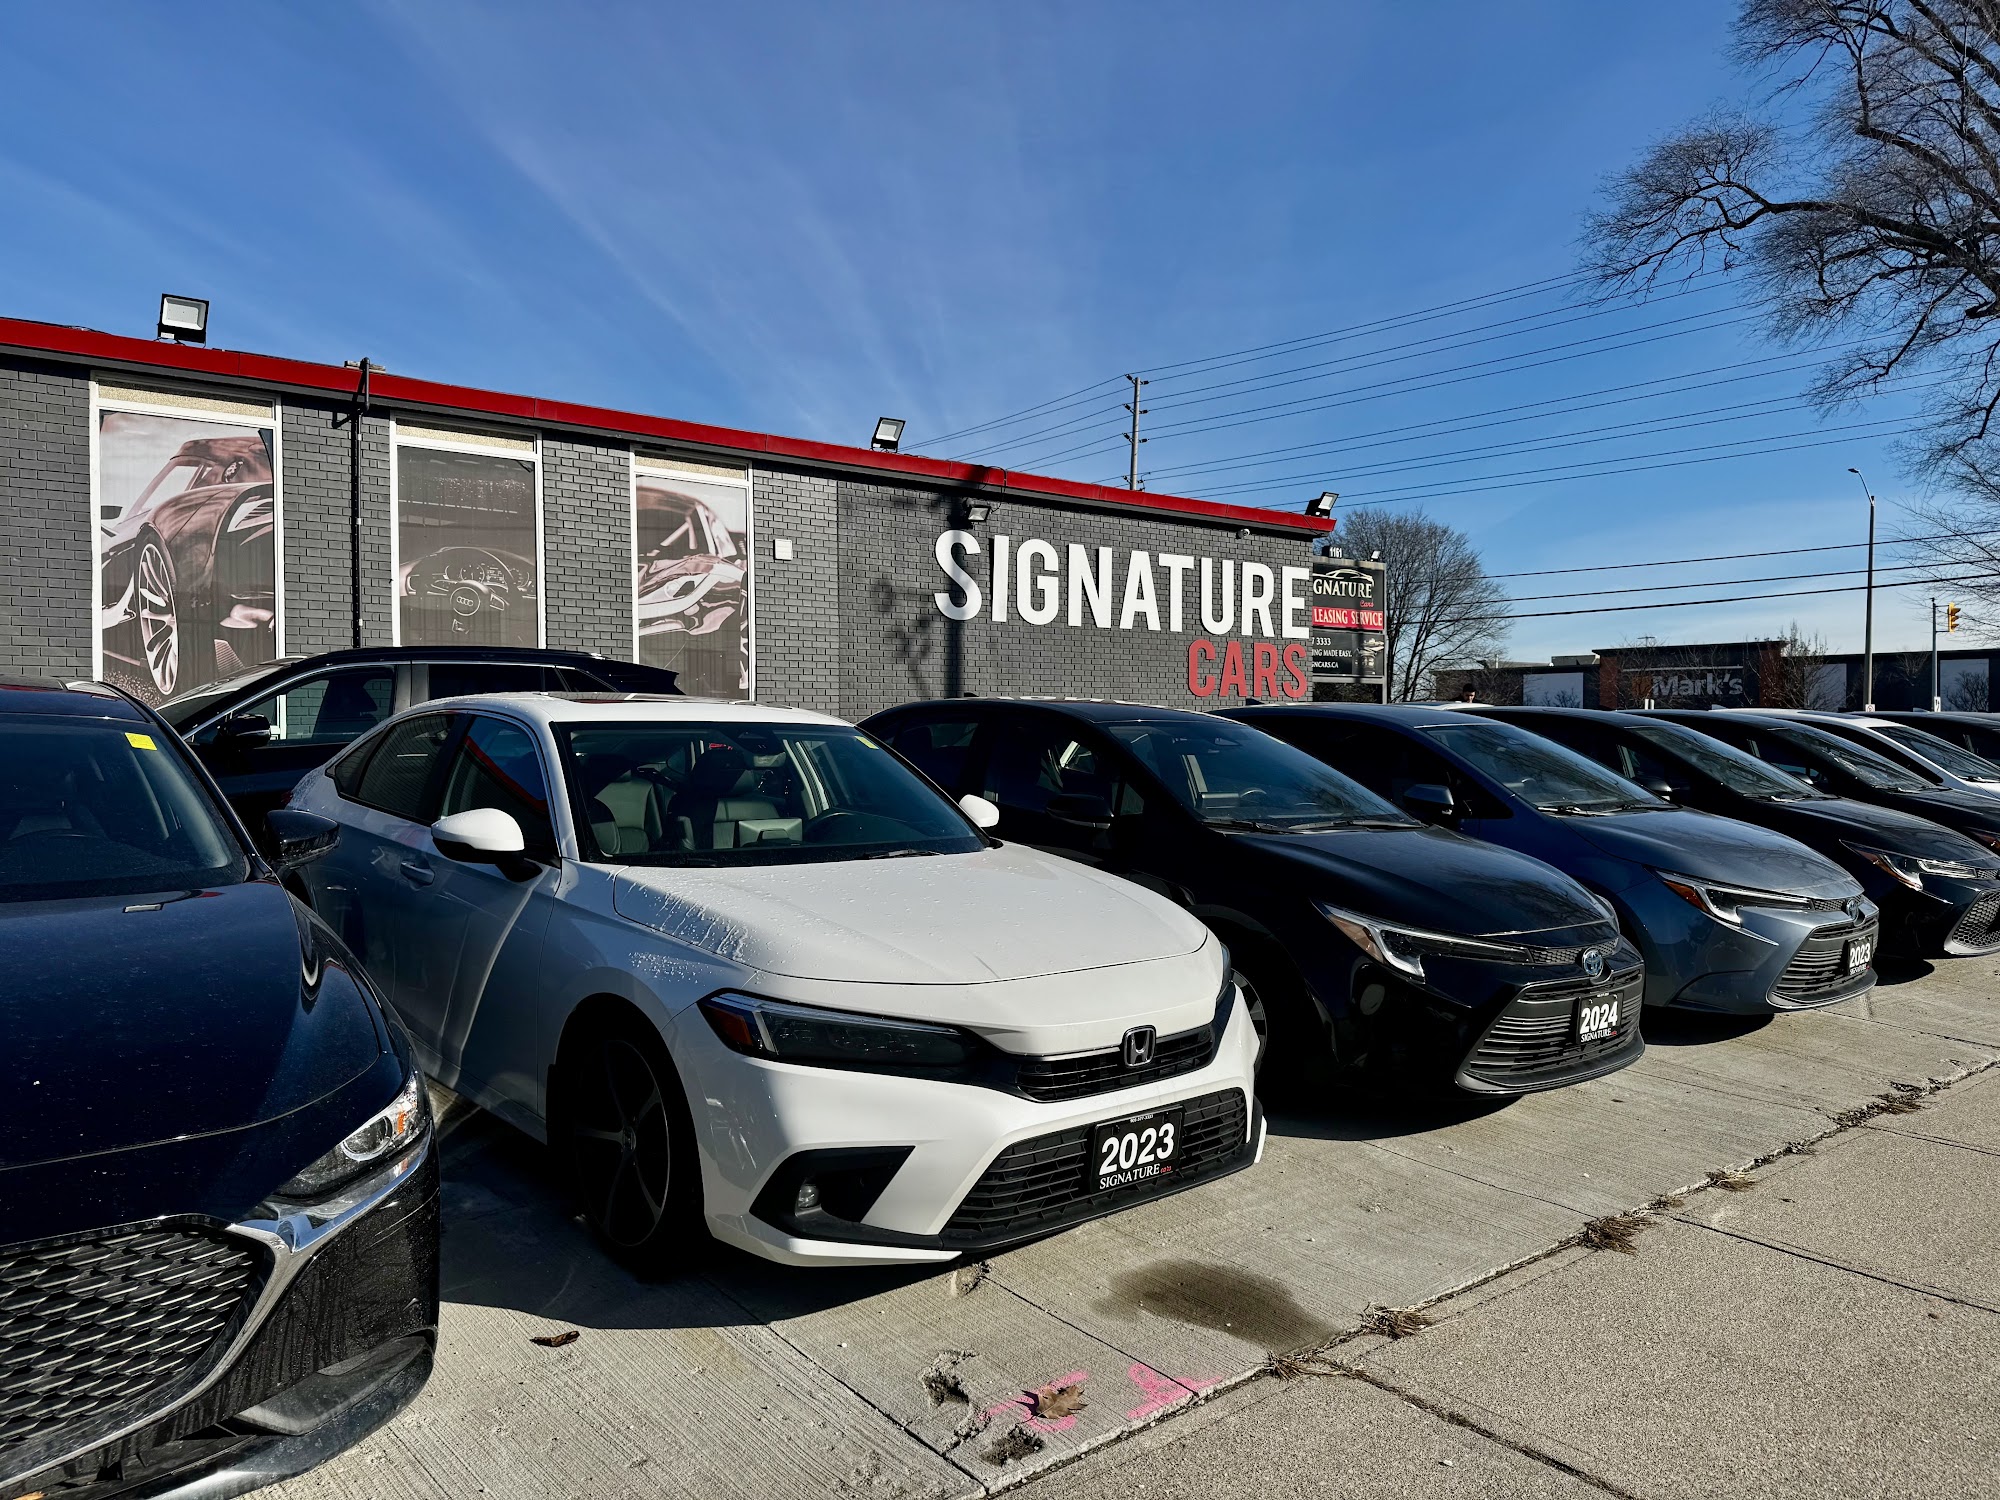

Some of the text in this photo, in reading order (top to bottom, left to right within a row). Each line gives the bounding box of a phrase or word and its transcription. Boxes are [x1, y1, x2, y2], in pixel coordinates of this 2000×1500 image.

[1329, 546, 1342, 558] 1161
[934, 529, 1310, 639] SIGNATURE
[1313, 579, 1372, 598] GNATURE
[1314, 608, 1382, 626] LEASING SERVICE
[1316, 637, 1331, 646] 3333
[1323, 649, 1338, 657] MADE
[1187, 639, 1308, 698] CARS
[1652, 673, 1742, 696] Mark's
[1850, 942, 1870, 968] 2023
[1580, 1001, 1617, 1034] 2024
[1099, 1123, 1174, 1175] 2023
[1099, 1163, 1160, 1190] SIGNATURE
